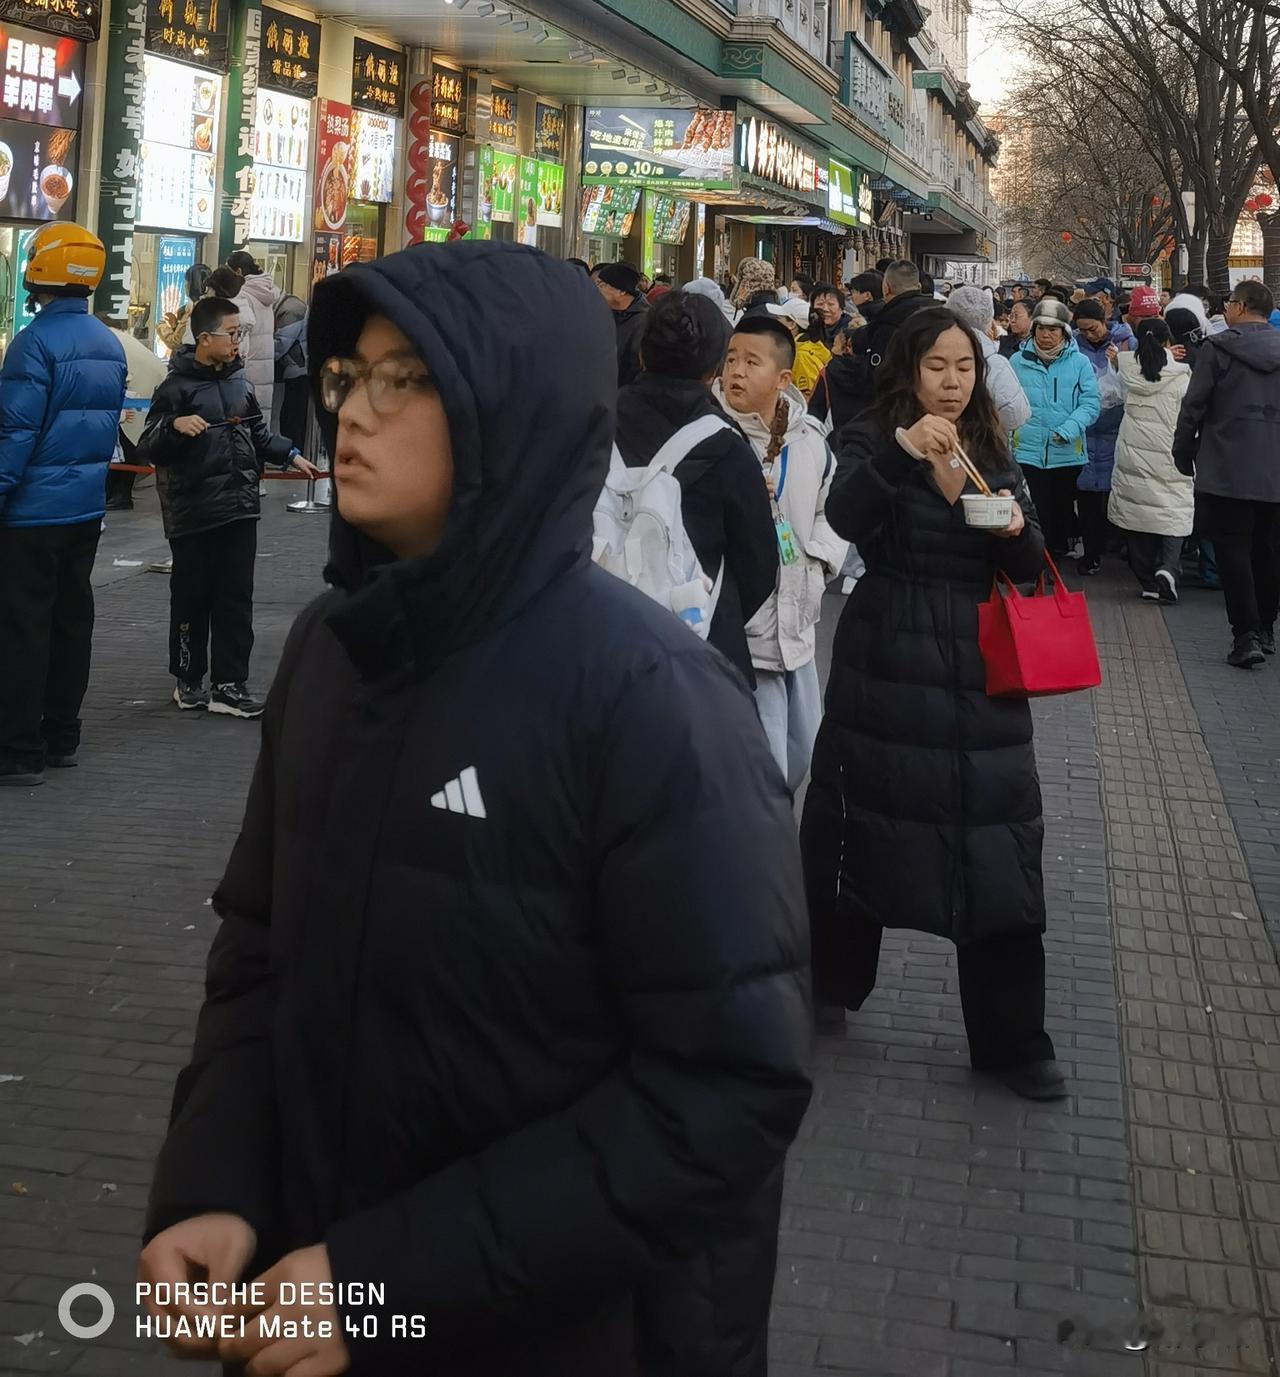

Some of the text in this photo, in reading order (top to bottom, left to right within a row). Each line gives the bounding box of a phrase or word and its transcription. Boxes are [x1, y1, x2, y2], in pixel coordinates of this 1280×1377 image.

[163, 27, 209, 56] 时尚小吃
[3, 73, 54, 114] 羊肉串
